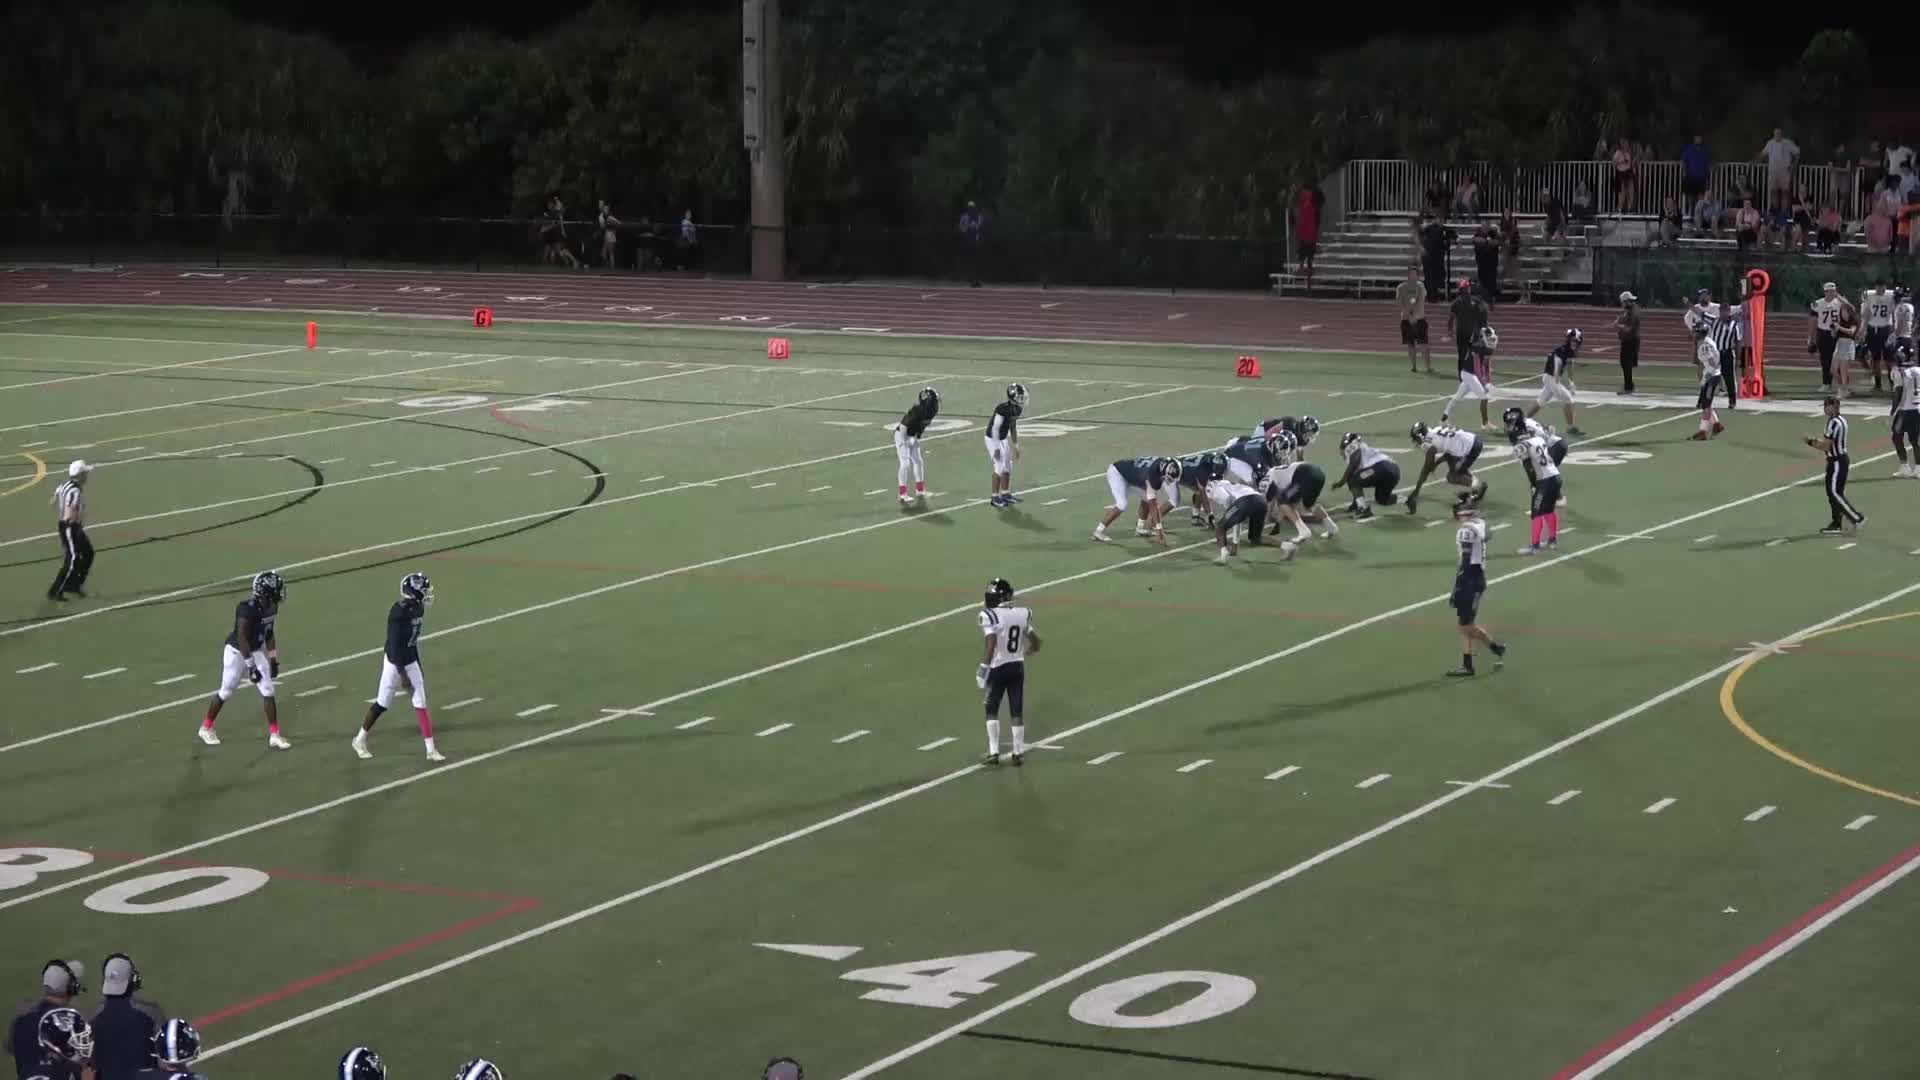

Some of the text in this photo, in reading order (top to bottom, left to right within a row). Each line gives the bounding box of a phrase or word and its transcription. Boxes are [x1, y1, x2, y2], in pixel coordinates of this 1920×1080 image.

[476, 310, 487, 325] G
[1822, 310, 1838, 324] 75
[1238, 358, 1254, 375] 20
[1006, 624, 1021, 654] 8
[839, 949, 1257, 1029] 40
